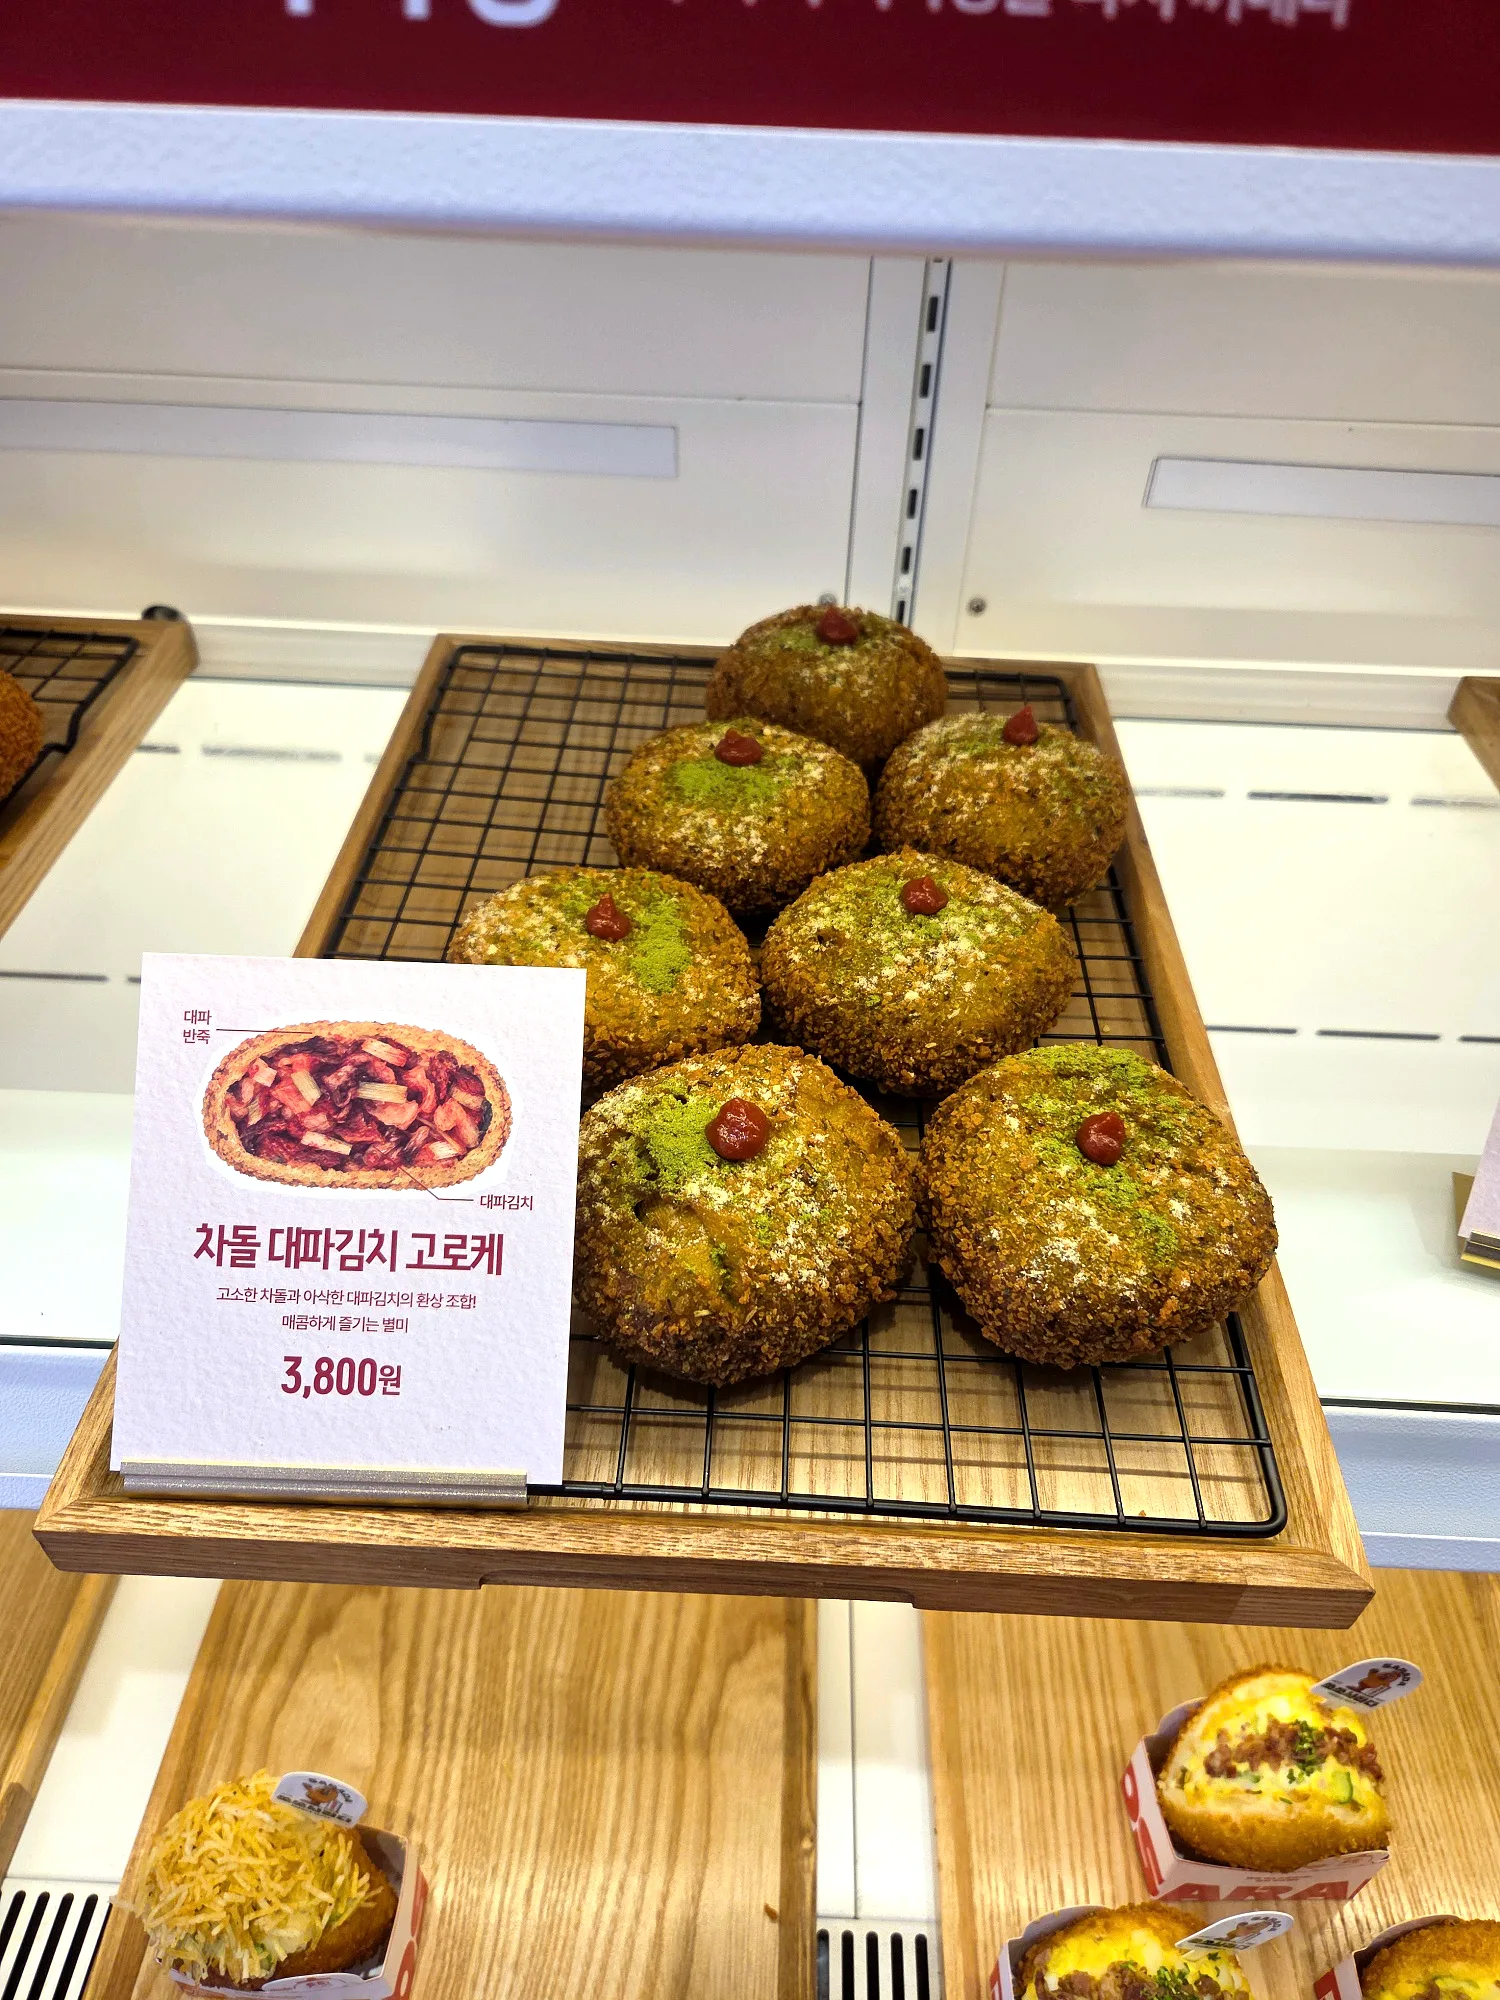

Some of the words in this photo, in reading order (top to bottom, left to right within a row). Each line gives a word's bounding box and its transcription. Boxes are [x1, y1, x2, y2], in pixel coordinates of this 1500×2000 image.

[183, 1009, 212, 1026] 대파
[182, 1028, 211, 1045] 반죽
[479, 1193, 534, 1212] 대파김치
[193, 1222, 262, 1269] 차돌
[267, 1226, 399, 1273] 대파김치
[405, 1232, 505, 1277] 고로케
[215, 1286, 259, 1304] 고소한
[259, 1287, 302, 1305] 차돌과
[303, 1288, 345, 1306] 아삭한
[346, 1290, 414, 1308] 대파김치의
[415, 1291, 445, 1309] 환상
[445, 1293, 477, 1310] 조합!
[281, 1313, 337, 1332] 매콤하게
[338, 1315, 380, 1333] 즐기는
[382, 1317, 409, 1334] 별미
[280, 1355, 402, 1400] 3,800원
